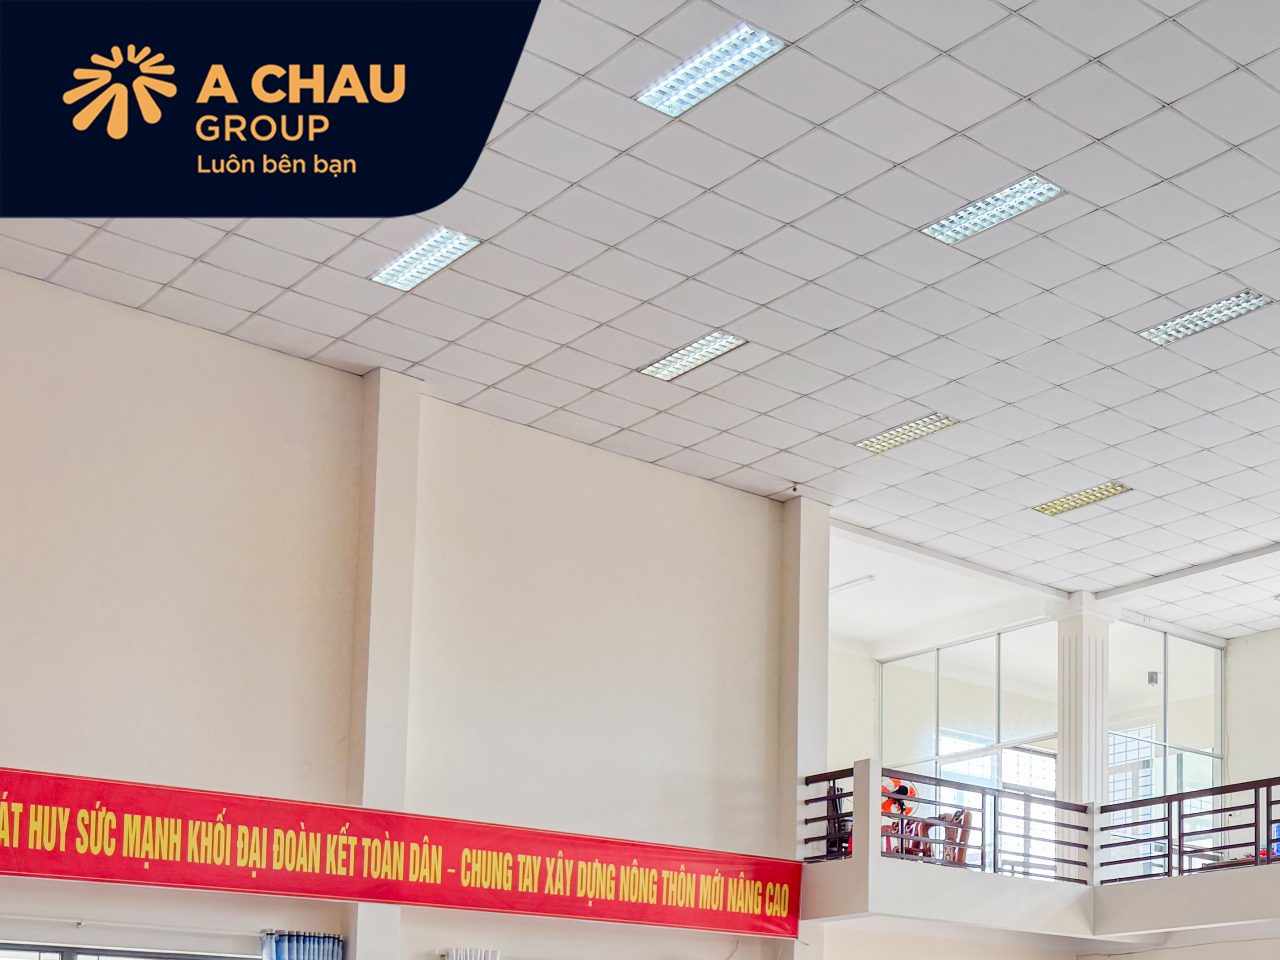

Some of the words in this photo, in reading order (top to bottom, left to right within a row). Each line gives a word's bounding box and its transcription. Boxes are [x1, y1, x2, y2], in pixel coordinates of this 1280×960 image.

[28, 804, 71, 852] HUY
[75, 800, 117, 857] SỨC
[122, 813, 182, 870] MẠNH
[187, 807, 232, 866] KHỐI
[236, 824, 268, 878] ĐẠI
[272, 821, 322, 874] ĐOÀN
[325, 822, 358, 877] KẾT
[361, 831, 405, 881] TOÀN
[408, 835, 443, 885] DÂN
[460, 847, 513, 891] CHUNG
[517, 853, 542, 894] TAY
[544, 851, 575, 897] XÂY
[576, 858, 616, 907] DỰNG
[618, 858, 658, 905] NÔNG
[661, 864, 697, 909] THÔN
[699, 868, 725, 911] MỚI
[727, 871, 763, 915] NÂNG
[765, 881, 790, 918] CAO
